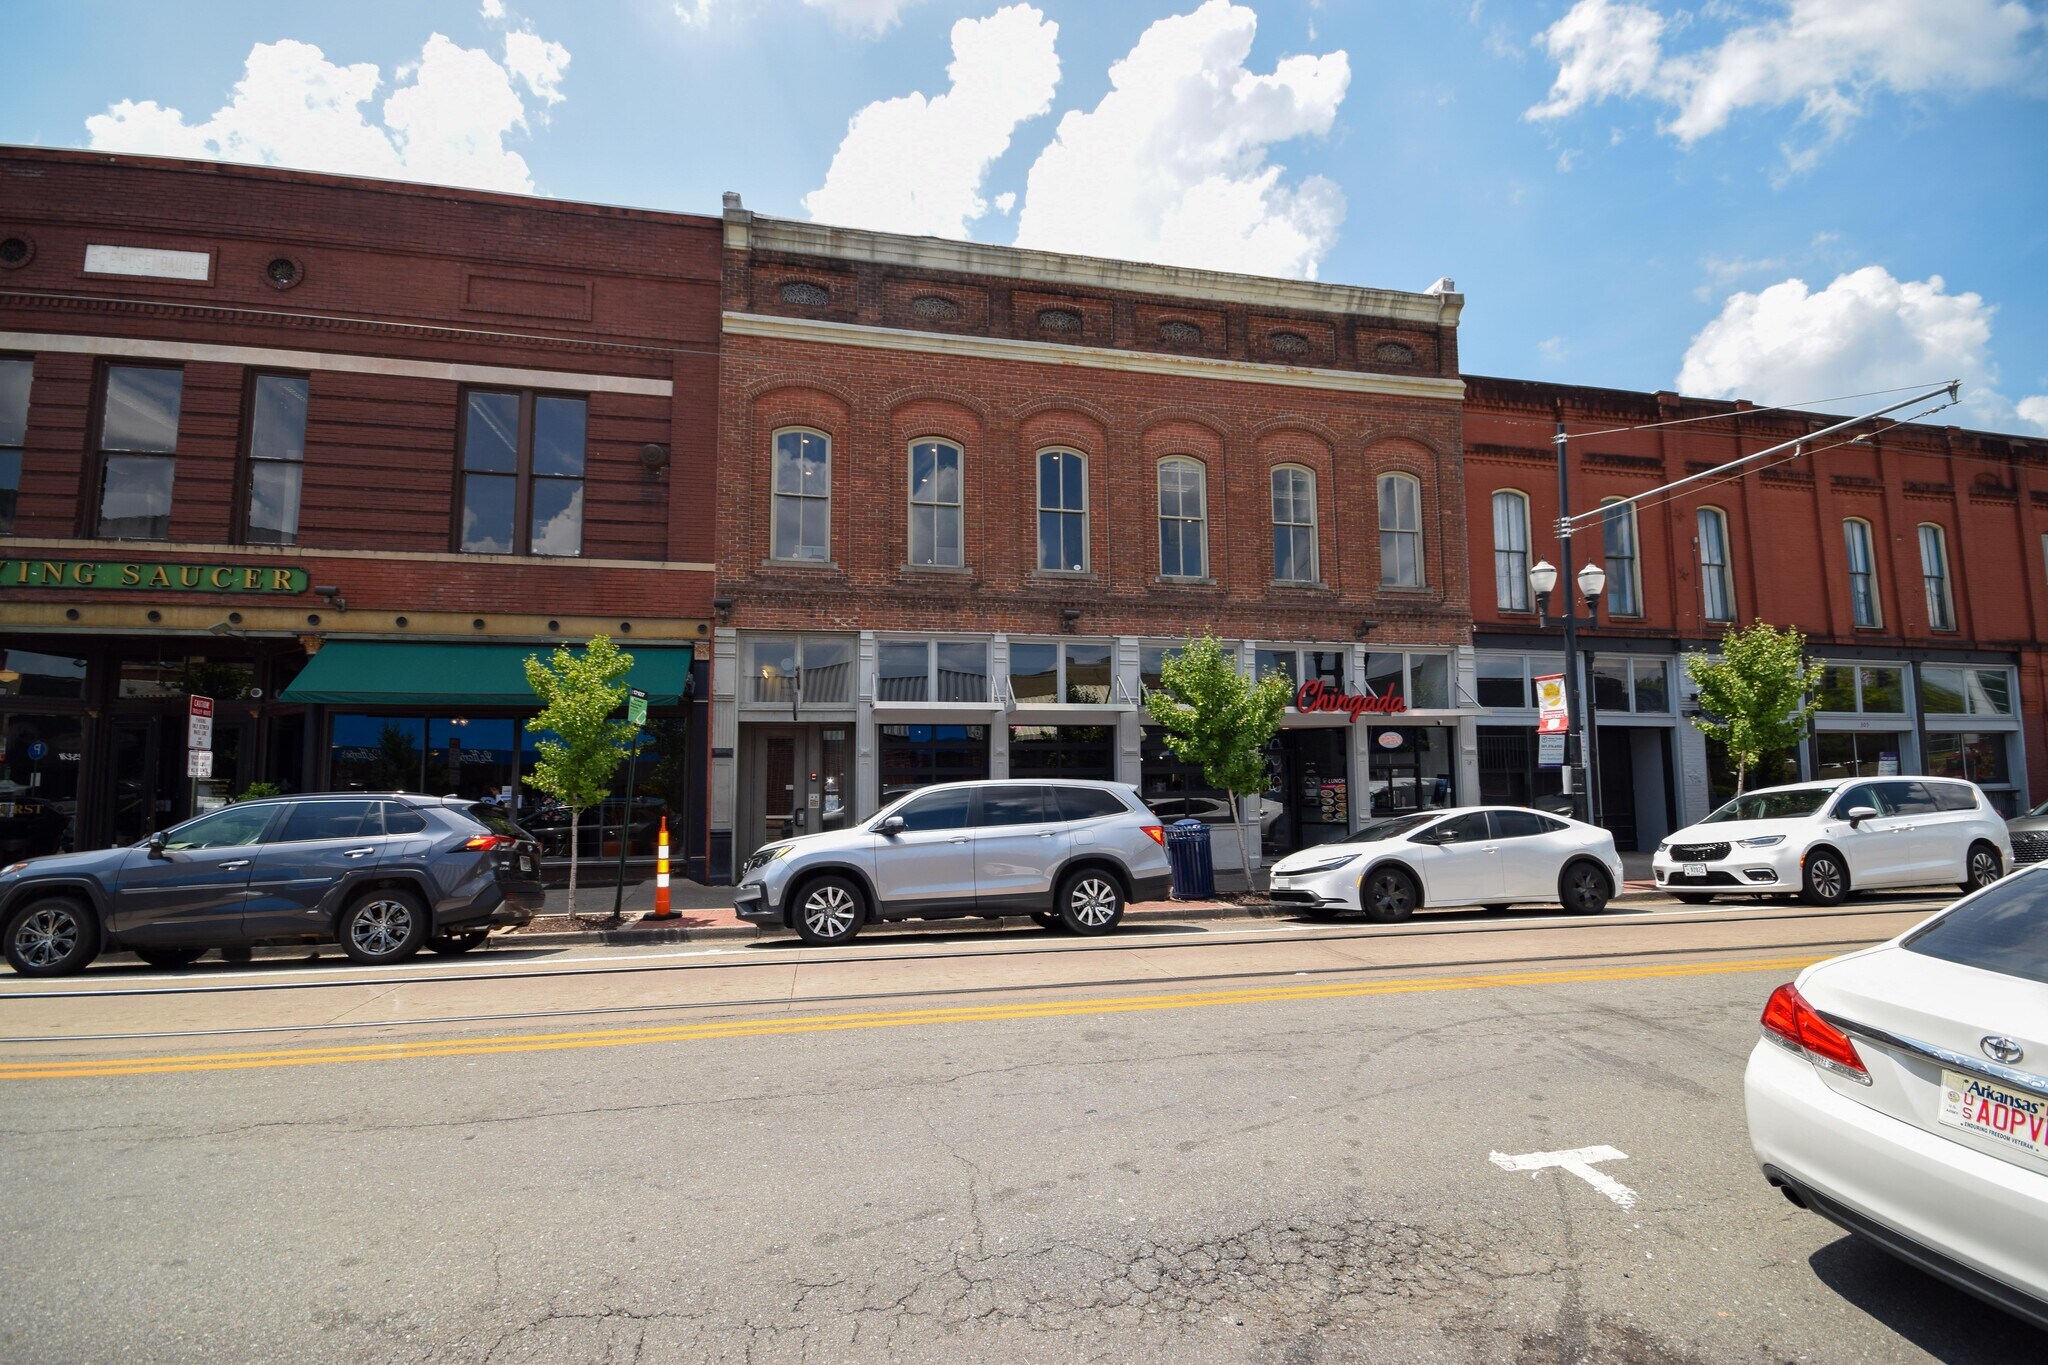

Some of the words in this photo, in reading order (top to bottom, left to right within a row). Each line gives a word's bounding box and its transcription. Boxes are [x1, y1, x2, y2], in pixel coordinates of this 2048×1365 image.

[0, 560, 97, 584] ING
[120, 564, 293, 591] SAUCER
[1297, 679, 1407, 723] Chingada
[1967, 1080, 2039, 1114] Arkansas
[1964, 1121, 1988, 1134] ENDURING
[1988, 1129, 2011, 1142] FREEDOM
[2011, 1138, 2034, 1151] VETERAN
